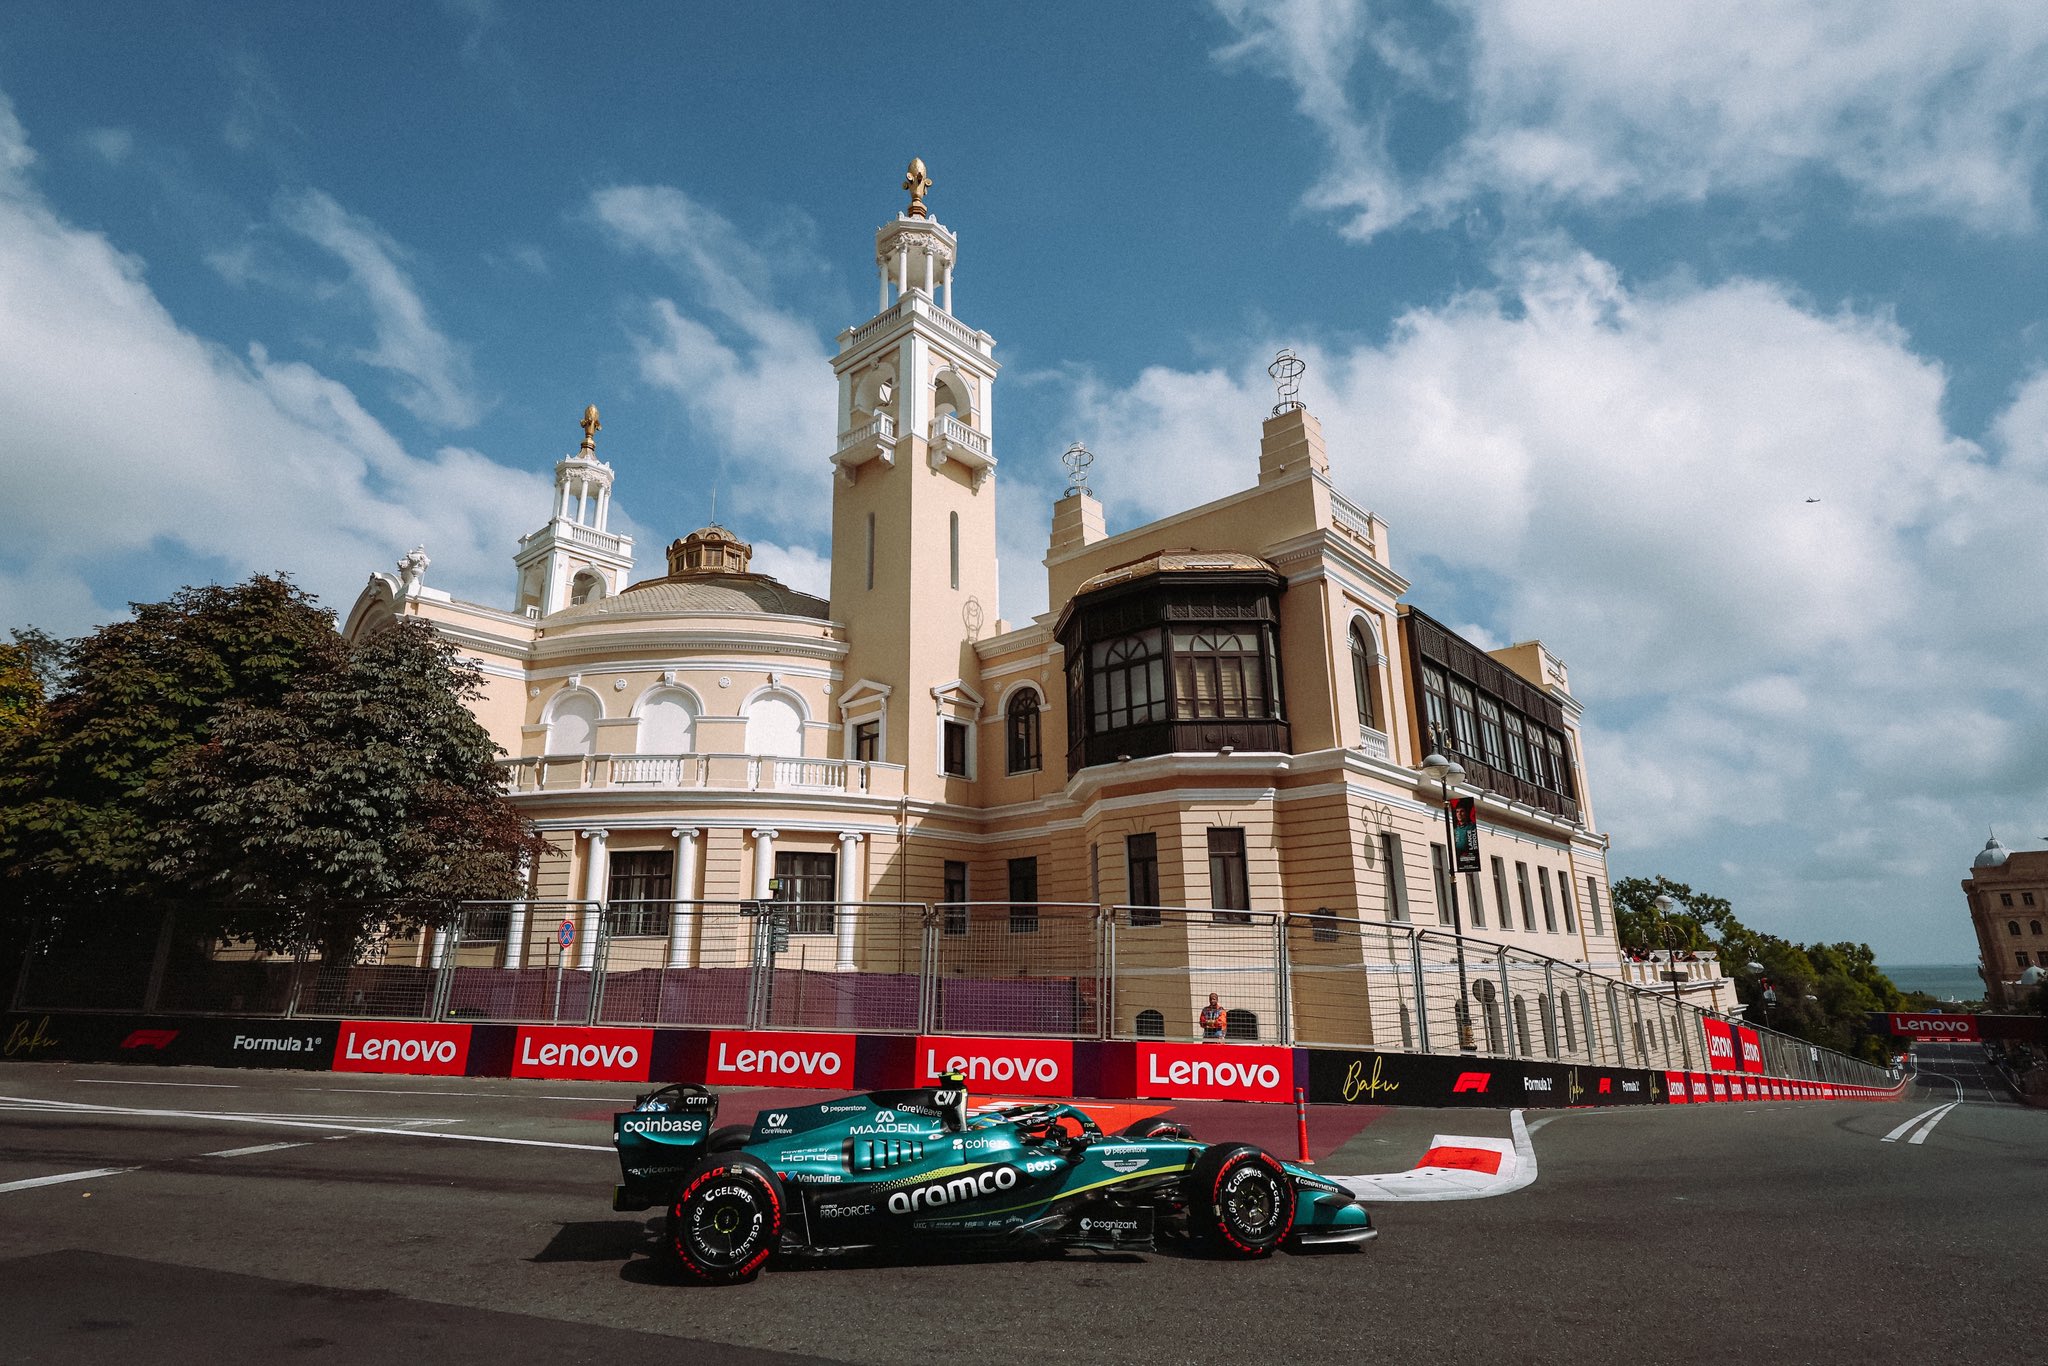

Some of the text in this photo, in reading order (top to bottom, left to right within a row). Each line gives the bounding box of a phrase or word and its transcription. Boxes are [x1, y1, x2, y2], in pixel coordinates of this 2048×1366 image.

[1897, 1017, 1969, 1032] Lenovo
[4, 1016, 59, 1056] Baku
[233, 1035, 302, 1051] Formula
[1707, 1028, 1733, 1058] Lenovo
[345, 1032, 457, 1063] Lenovo
[521, 1037, 639, 1068] Lenovo
[1740, 1035, 1760, 1062] Lenovo
[717, 1042, 841, 1075] Lenovo
[927, 1049, 1059, 1082] Lenovo
[1149, 1053, 1280, 1089] Lenovo
[1342, 1055, 1400, 1102] Baku
[1523, 1076, 1548, 1092] Formula
[1667, 1078, 1685, 1096] Lenovo
[686, 1096, 708, 1105] arm
[829, 1105, 867, 1113] pepperstone
[897, 1103, 943, 1117] CoreWeave
[623, 1116, 702, 1133] coinbase
[850, 1123, 920, 1135] MAADEN
[781, 1153, 838, 1162] Honda
[1112, 1147, 1147, 1155] pepperstone
[627, 1165, 686, 1175] servicen
[1026, 1160, 1057, 1173] BOSS
[1233, 1169, 1262, 1186] CELSIUS
[1299, 1178, 1339, 1194] COINPAYMENTS
[714, 1186, 753, 1203] CELSIUS
[888, 1167, 1017, 1215] aramco
[1268, 1190, 1280, 1228] CELSIUS
[1092, 1216, 1138, 1231] cognizant
[729, 1224, 760, 1259] CELSIUS
